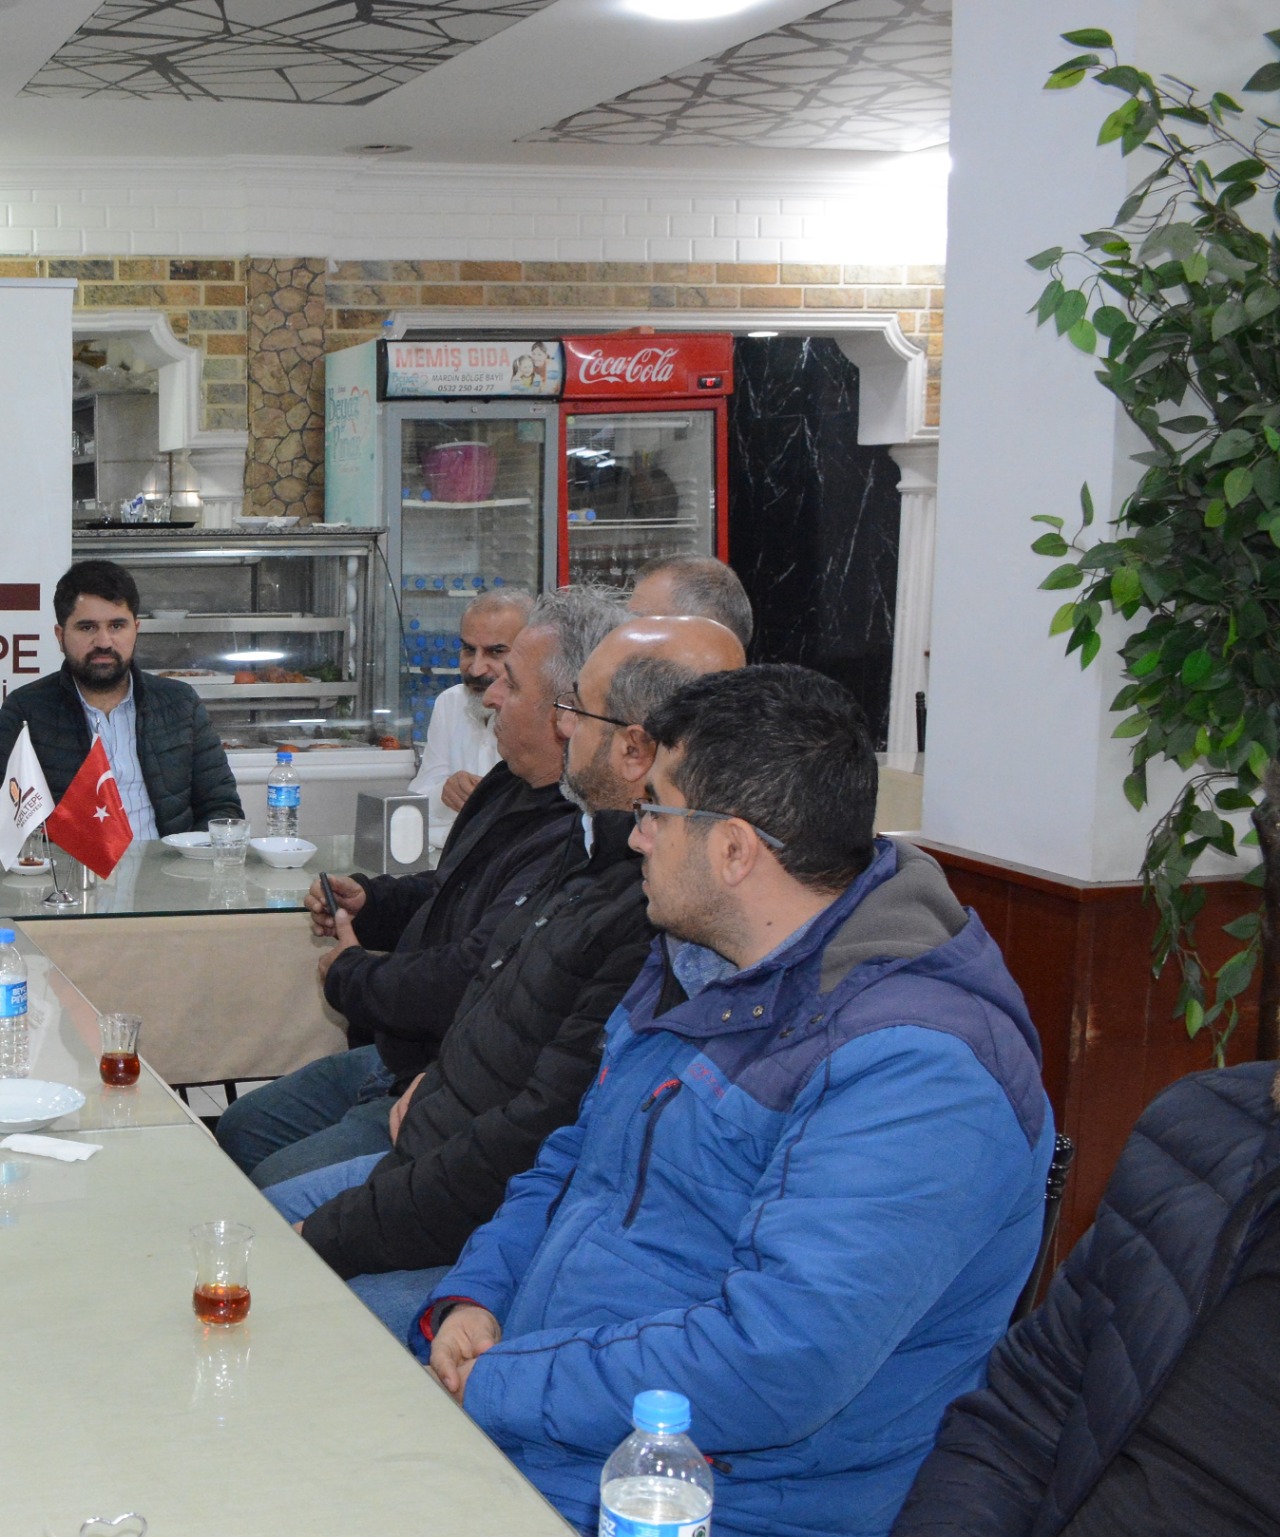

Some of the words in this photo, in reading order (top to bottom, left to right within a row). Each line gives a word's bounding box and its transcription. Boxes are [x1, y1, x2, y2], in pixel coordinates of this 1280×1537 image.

[395, 345, 462, 371] MEMİŞ
[468, 348, 511, 368] GIDA
[579, 347, 679, 384] Coca-Cola
[474, 384, 484, 392] 42
